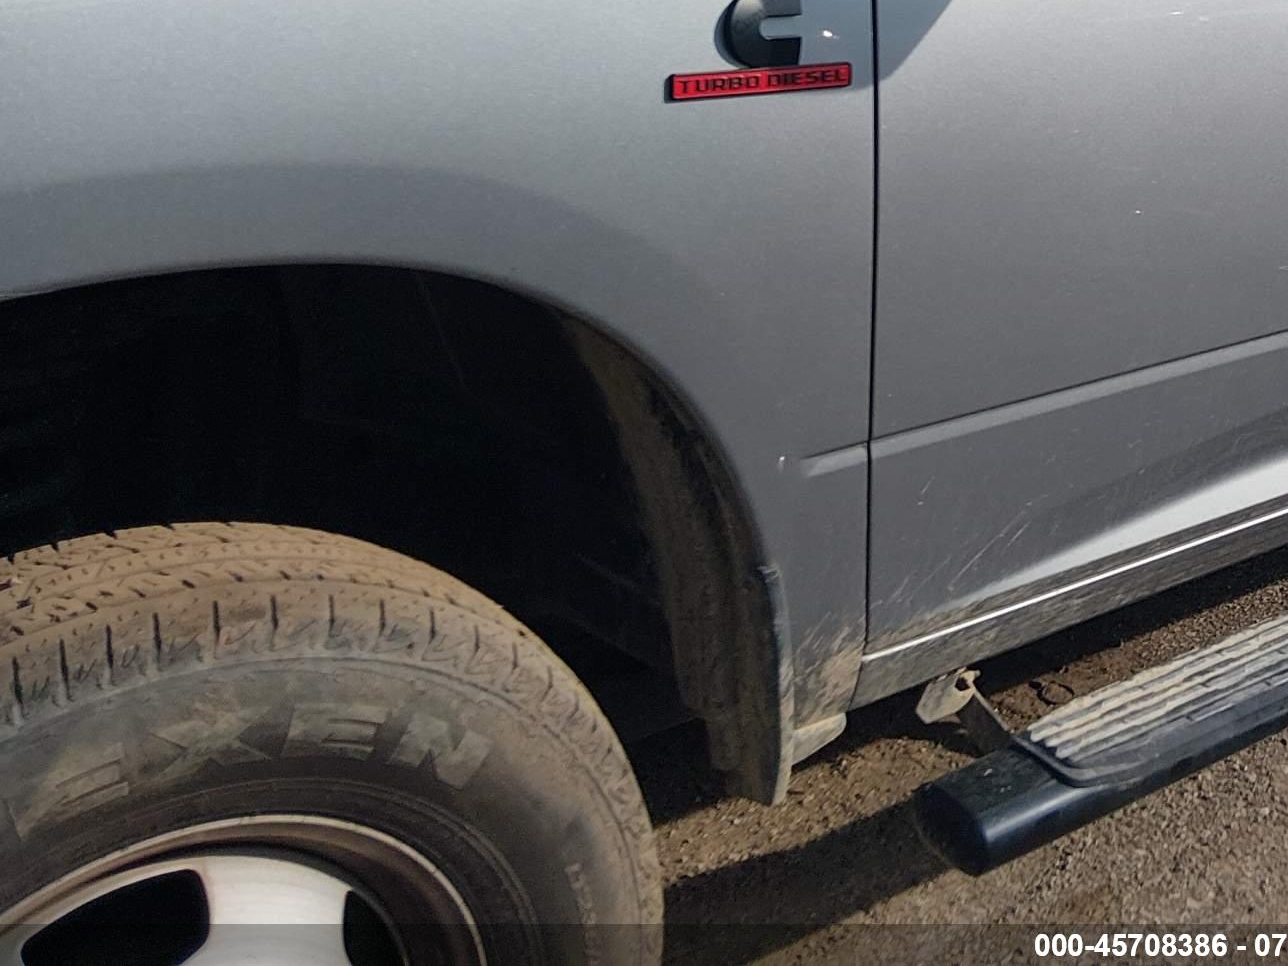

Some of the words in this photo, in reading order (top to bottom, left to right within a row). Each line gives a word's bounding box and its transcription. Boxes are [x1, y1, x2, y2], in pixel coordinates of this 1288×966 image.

[679, 74, 761, 94] TURBO
[767, 68, 847, 88] DIESEL
[10, 698, 494, 840] EXEN
